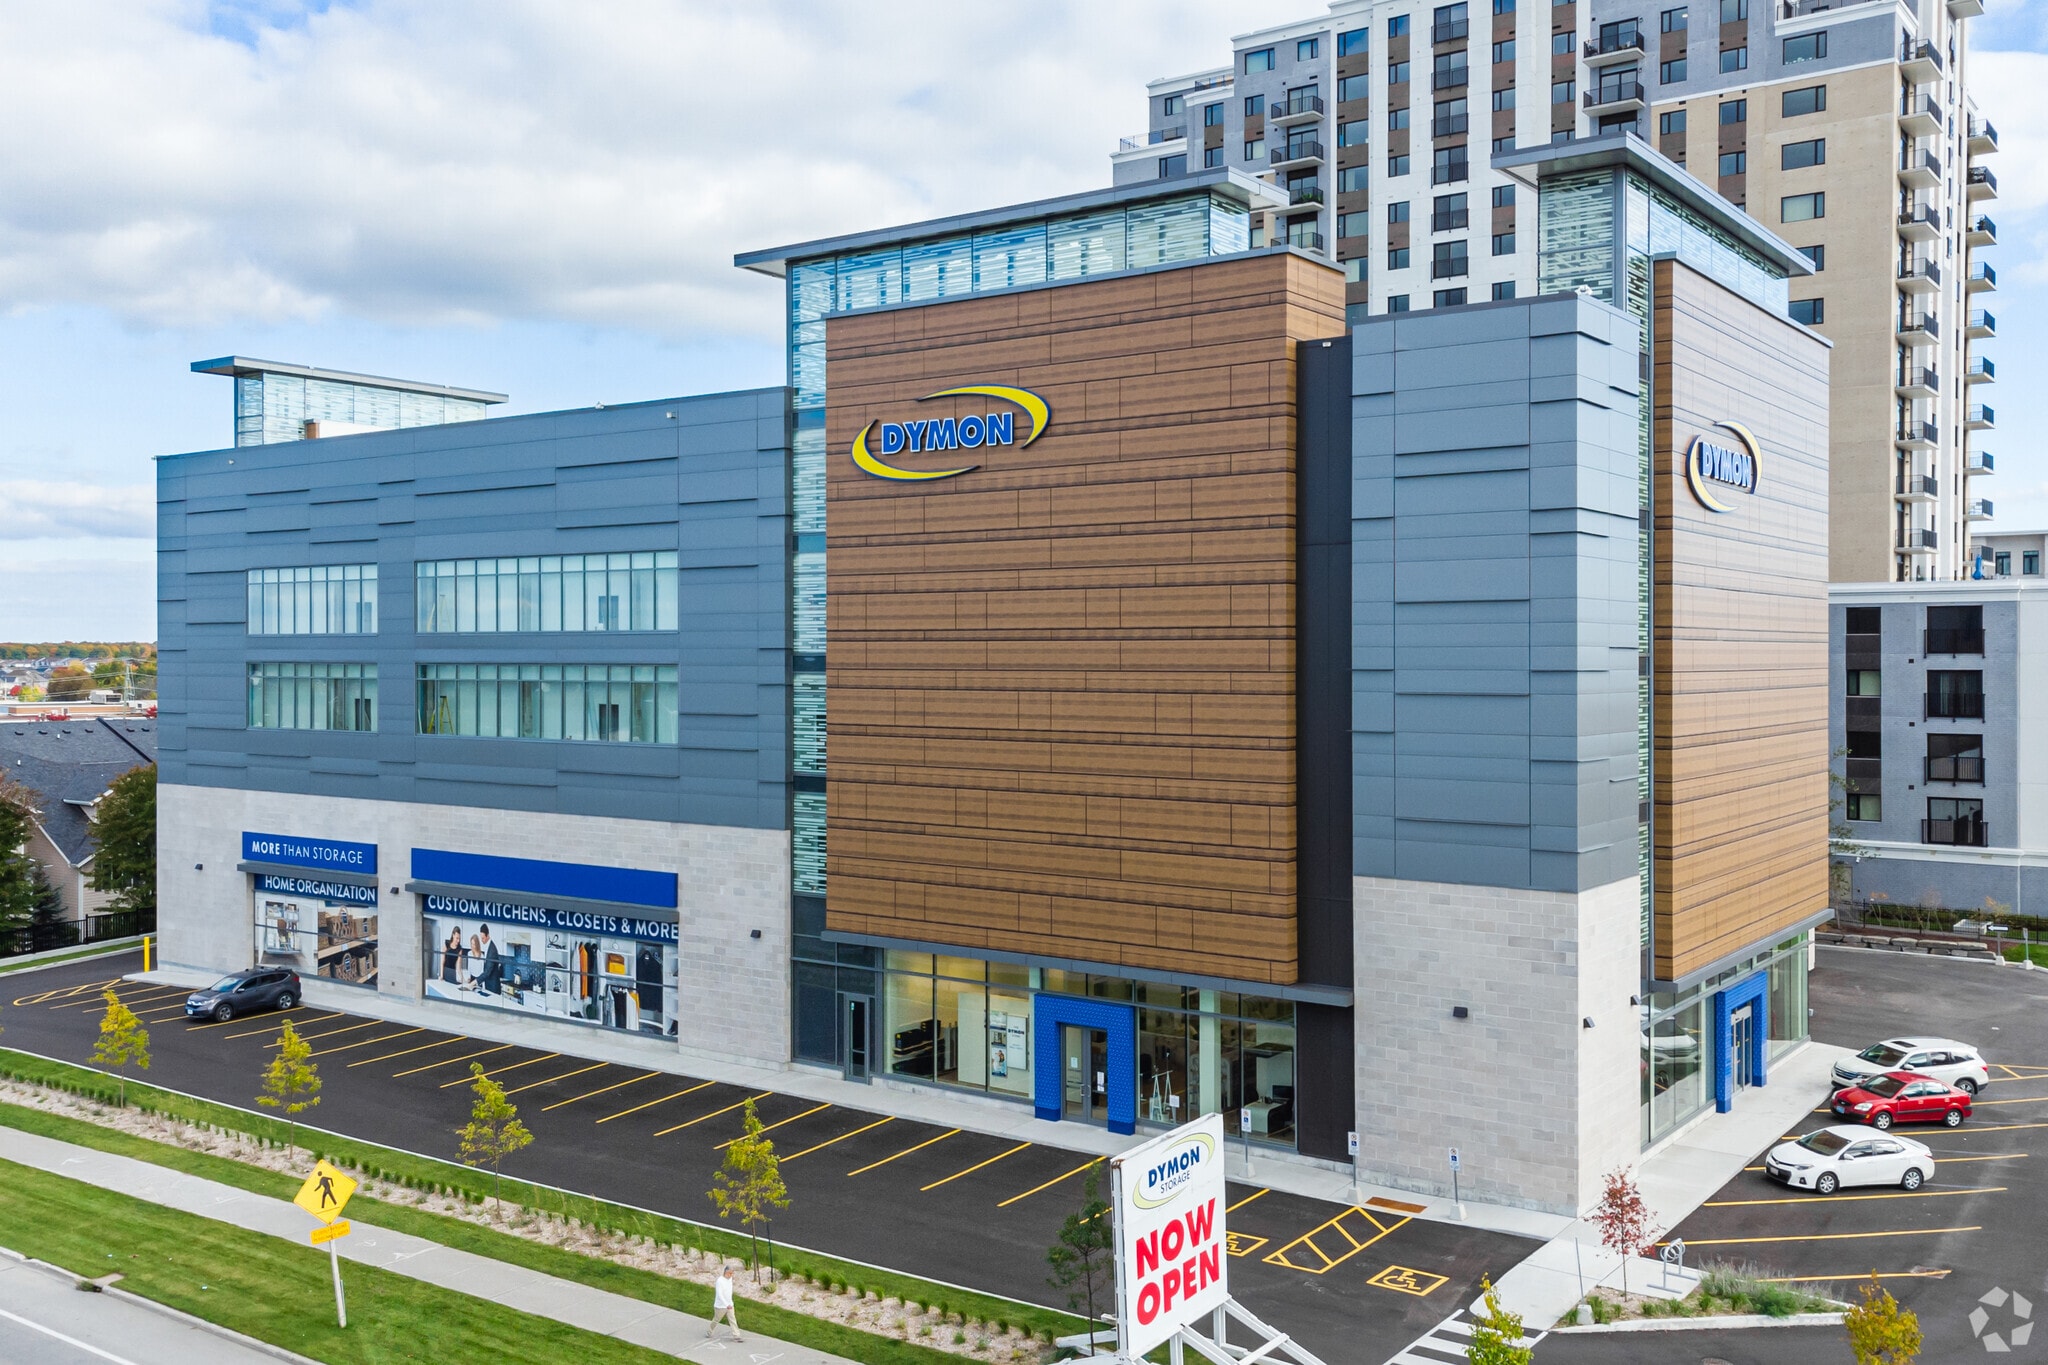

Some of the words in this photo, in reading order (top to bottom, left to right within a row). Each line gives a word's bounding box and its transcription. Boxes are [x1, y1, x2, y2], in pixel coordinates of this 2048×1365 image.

[881, 412, 1013, 455] DYMON
[1699, 441, 1752, 488] DYMON
[252, 841, 280, 855] MORE
[283, 843, 310, 858] THAN
[313, 846, 363, 864] STORAGE
[265, 875, 295, 891] HOME
[297, 879, 376, 902] ORGANIZATION
[428, 895, 480, 915] CUSTOM
[484, 902, 551, 926] KITCHENS,
[556, 910, 617, 932] CLOSETS
[621, 918, 631, 934] &
[635, 920, 679, 939] MORE
[1148, 1146, 1200, 1188] DYMON
[1160, 1170, 1190, 1194] STORAGE
[1136, 1197, 1216, 1280] NOW
[1137, 1242, 1220, 1326] OPEN
